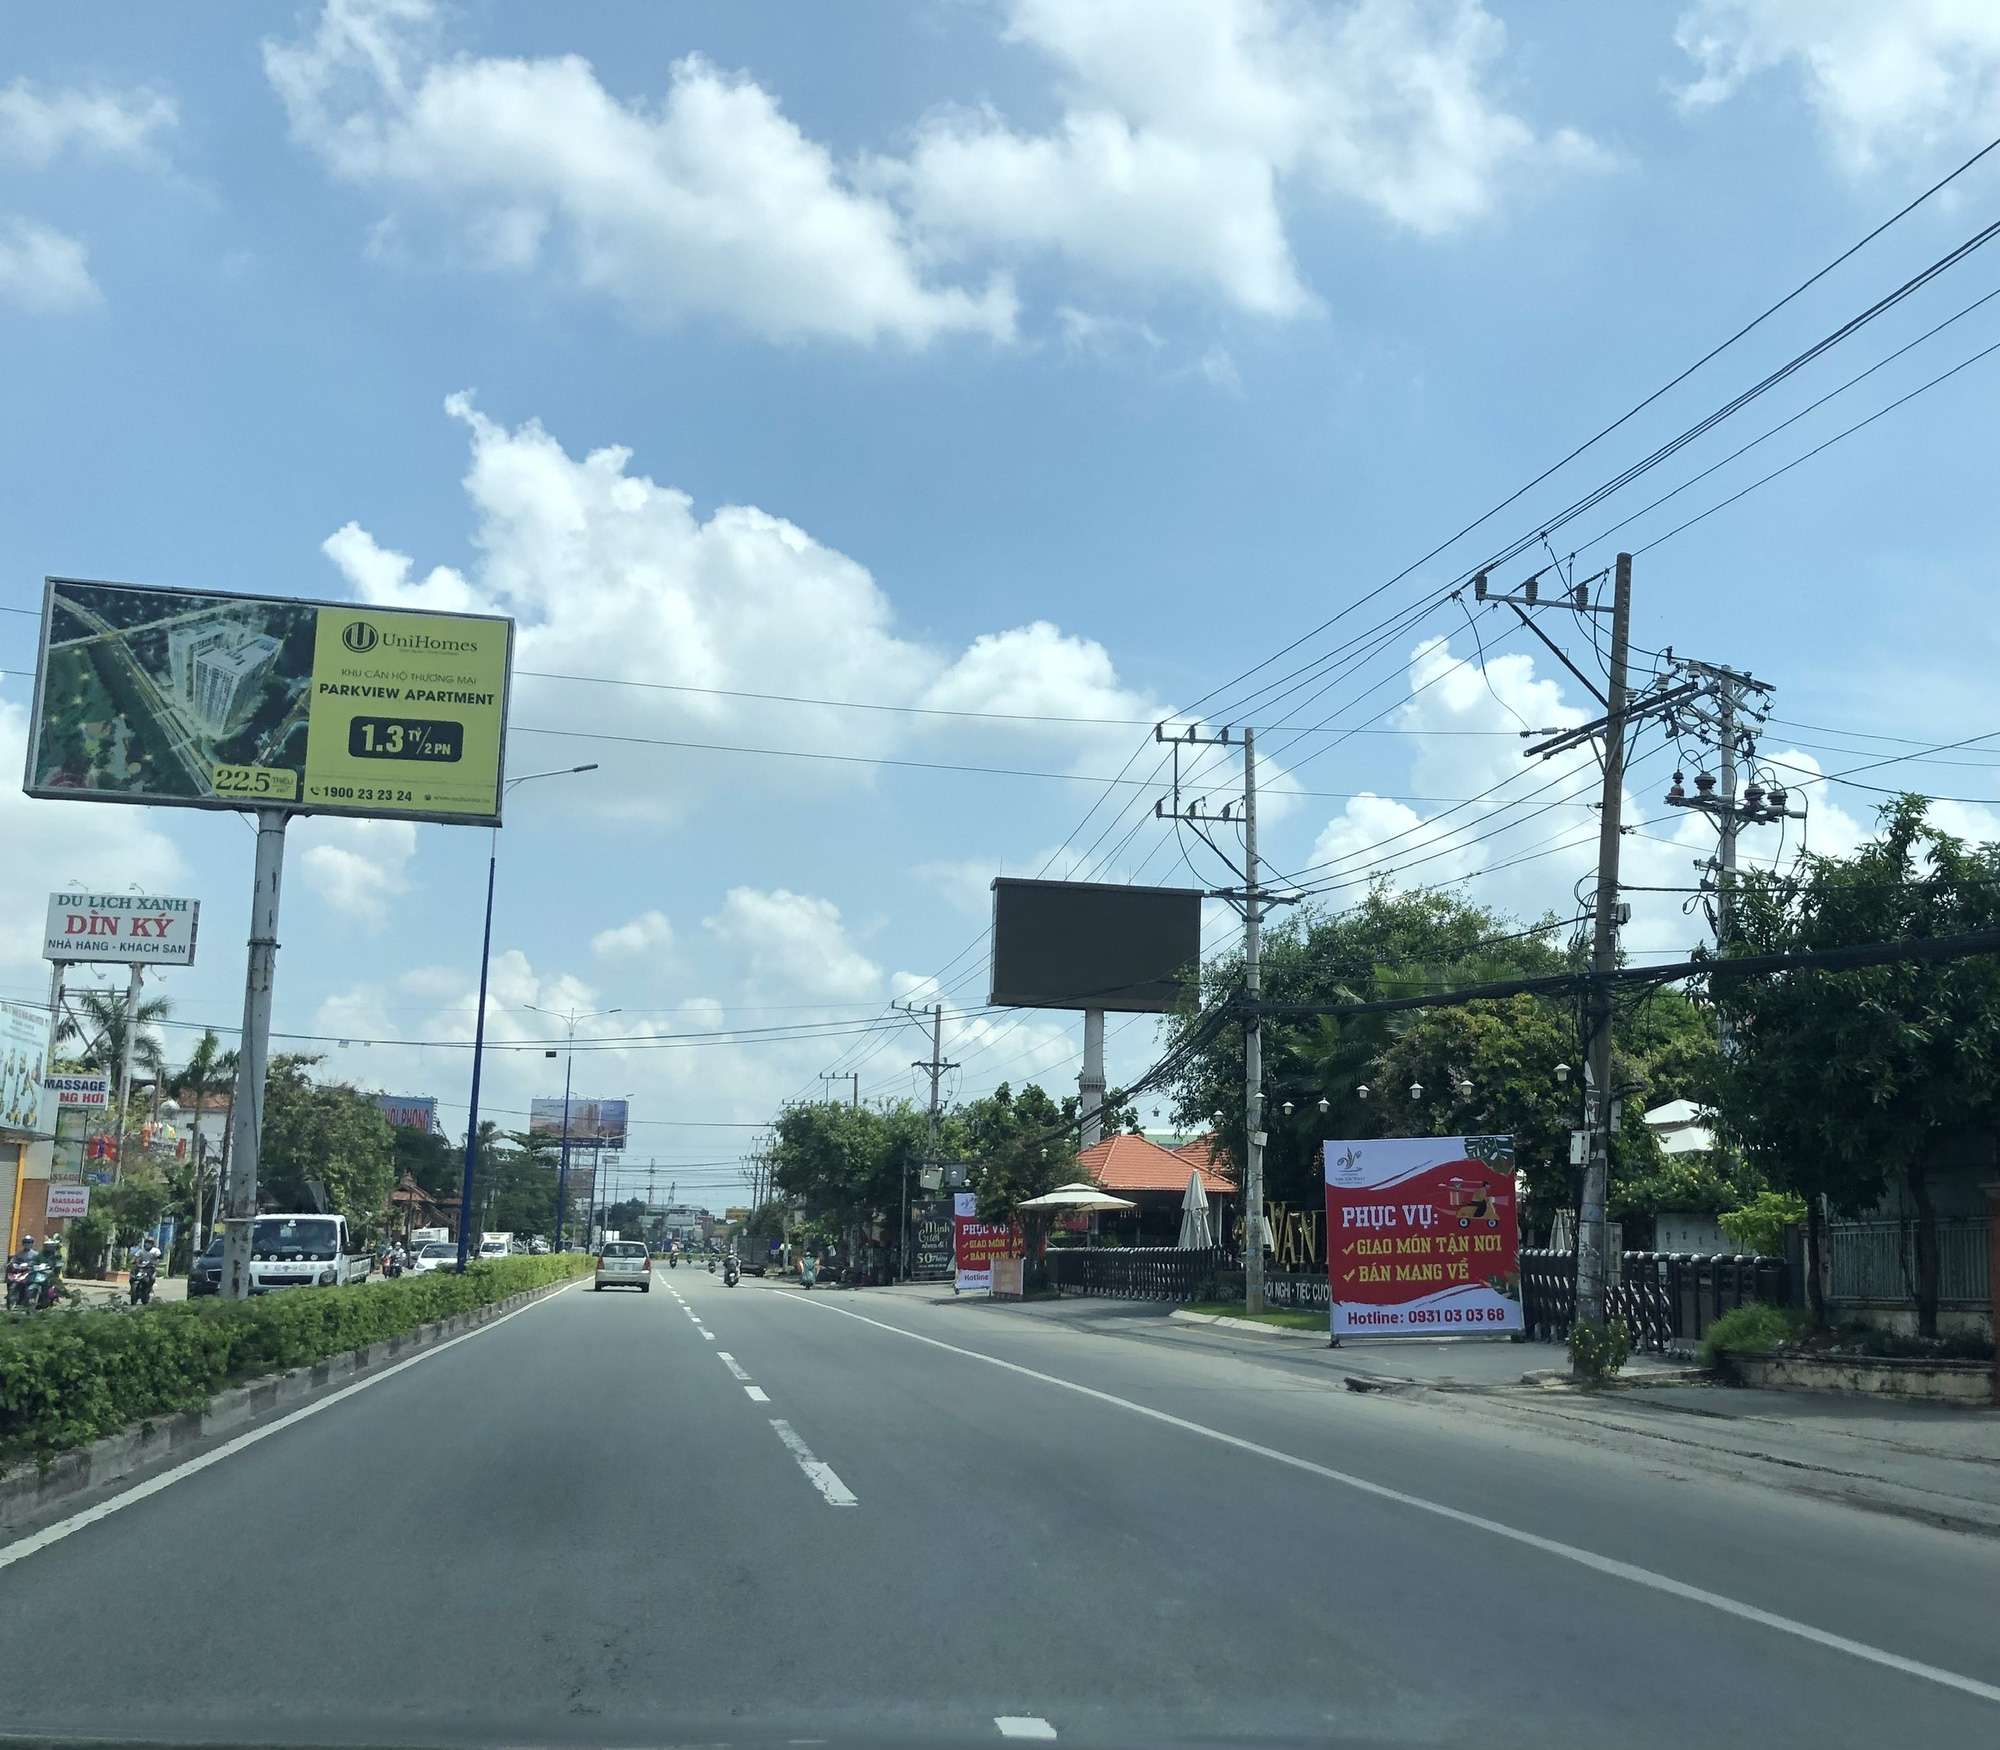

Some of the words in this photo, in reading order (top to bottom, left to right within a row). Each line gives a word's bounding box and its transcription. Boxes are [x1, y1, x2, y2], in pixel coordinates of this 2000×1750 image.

[383, 633, 478, 652] UniHomes
[341, 668, 362, 677] KHU
[411, 672, 454, 684] THƯƠNG
[319, 683, 400, 699] PARKVIEW
[405, 689, 494, 705] APARTMENT
[362, 723, 404, 753] 1.3
[216, 770, 271, 793] 22.5
[324, 786, 354, 799] 1900
[358, 788, 373, 800] 23
[378, 789, 393, 801] 23
[397, 790, 412, 802] 24
[57, 895, 83, 906] DU
[88, 896, 132, 911] LỊCH
[136, 898, 188, 911] XANH
[129, 912, 175, 938] KÝ
[44, 1078, 106, 1092] MASSAGE
[59, 1092, 78, 1102] NG
[1342, 1205, 1397, 1231] PHỤC
[1402, 1204, 1439, 1230] VỤ:
[963, 1224, 988, 1236] PHỤC
[969, 1239, 987, 1248] GIAO
[988, 1237, 1005, 1248] MÓN
[1357, 1238, 1392, 1255] GIAO
[1396, 1233, 1431, 1254] MÓN
[1436, 1233, 1470, 1256] TẬN
[1474, 1234, 1502, 1252] NƠI
[916, 1252, 932, 1263] 50
[970, 1250, 986, 1261] BÁN
[964, 1272, 989, 1281] Hotline
[1358, 1261, 1392, 1282] BÁN
[1396, 1263, 1442, 1282] MANG
[1446, 1256, 1470, 1280] VỀ
[1312, 1279, 1330, 1302] CƯỚ
[1348, 1311, 1404, 1325] Hotline:
[1408, 1309, 1441, 1323] 0931
[1444, 1309, 1462, 1322] 03
[1465, 1308, 1484, 1322] 03
[1487, 1307, 1505, 1322] 68
